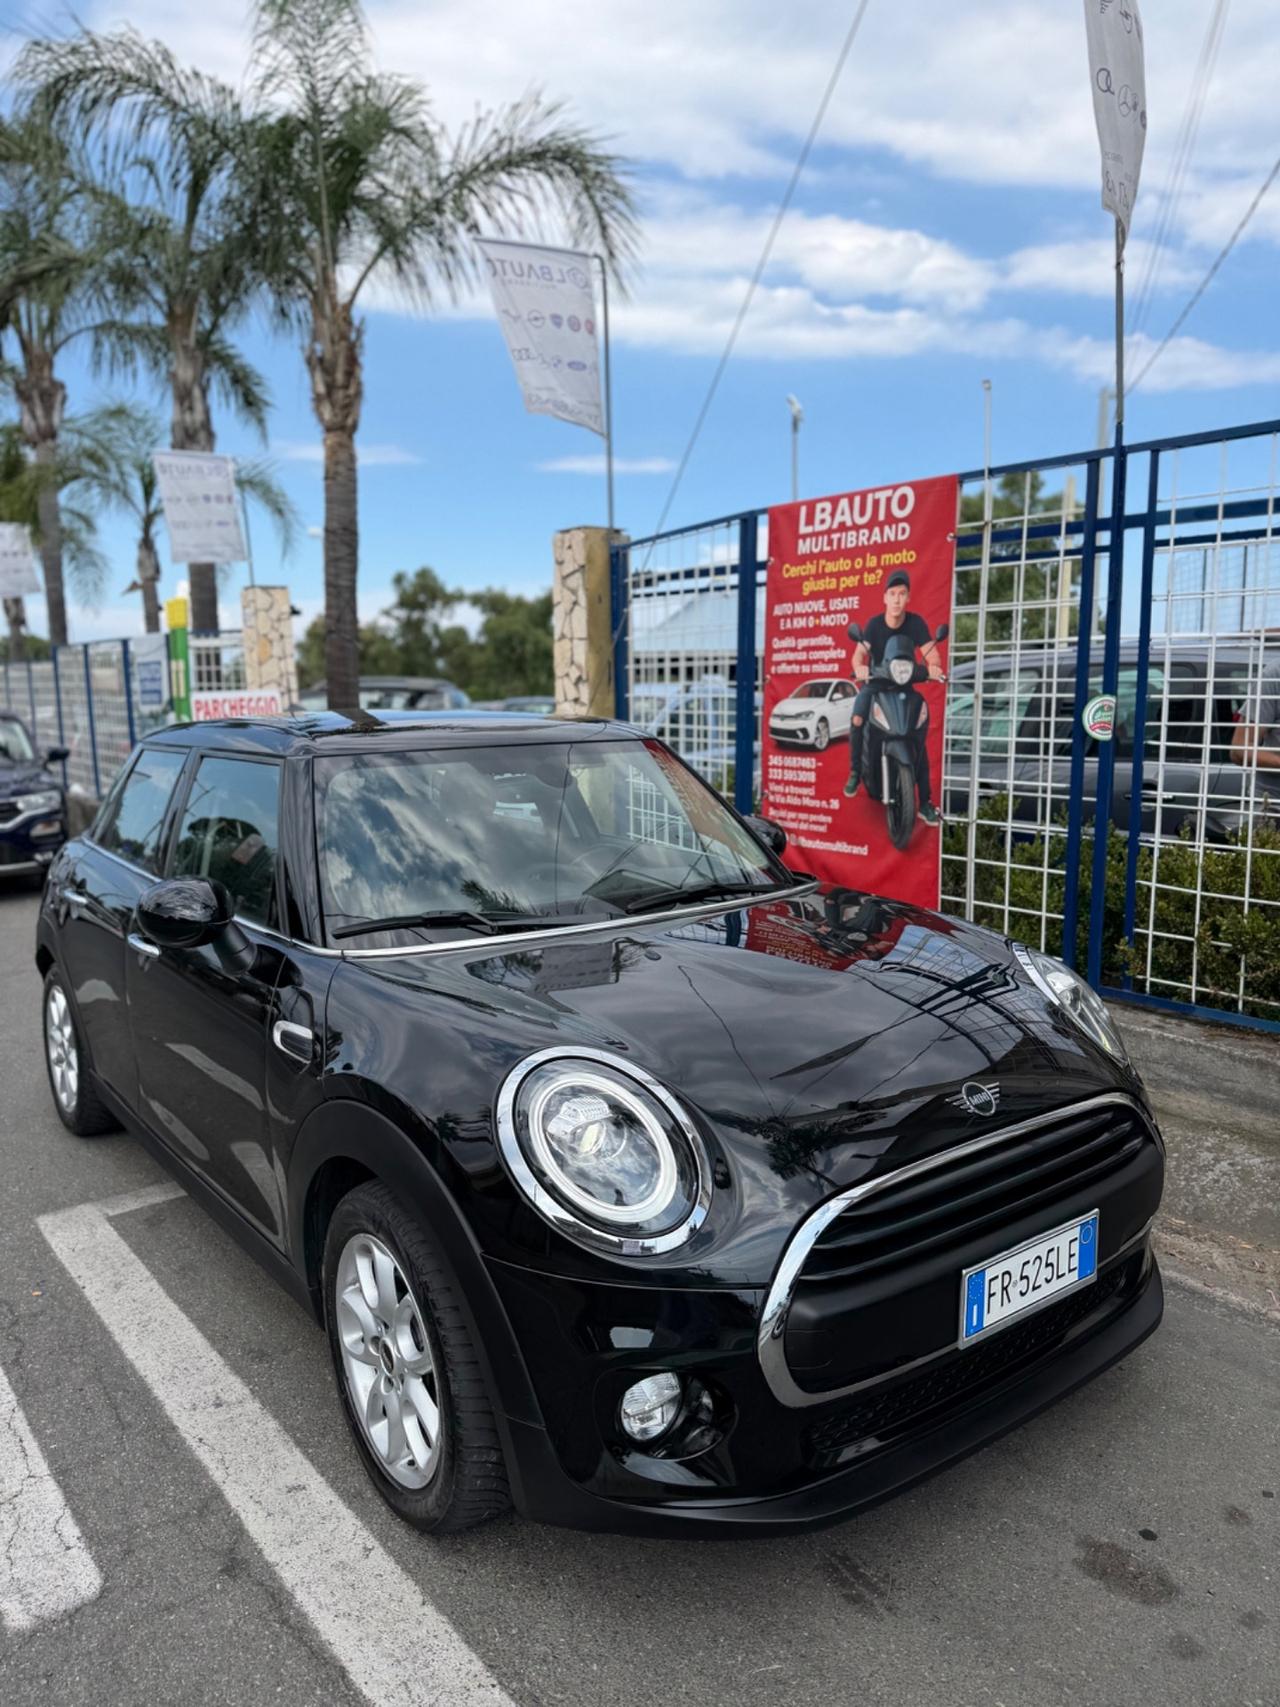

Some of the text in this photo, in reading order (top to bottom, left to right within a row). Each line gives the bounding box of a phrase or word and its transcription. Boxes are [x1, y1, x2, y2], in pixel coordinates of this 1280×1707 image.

[798, 485, 915, 534] LBAUTO
[797, 522, 911, 555] MULTIBRAND
[783, 548, 916, 578] Cerchi l'auto o la moto
[802, 569, 883, 596] giusta per te?
[794, 599, 827, 614] NUOVE,
[829, 596, 860, 611] USATE
[821, 613, 848, 627] MOTO
[194, 696, 279, 720] PARCHEGGIO
